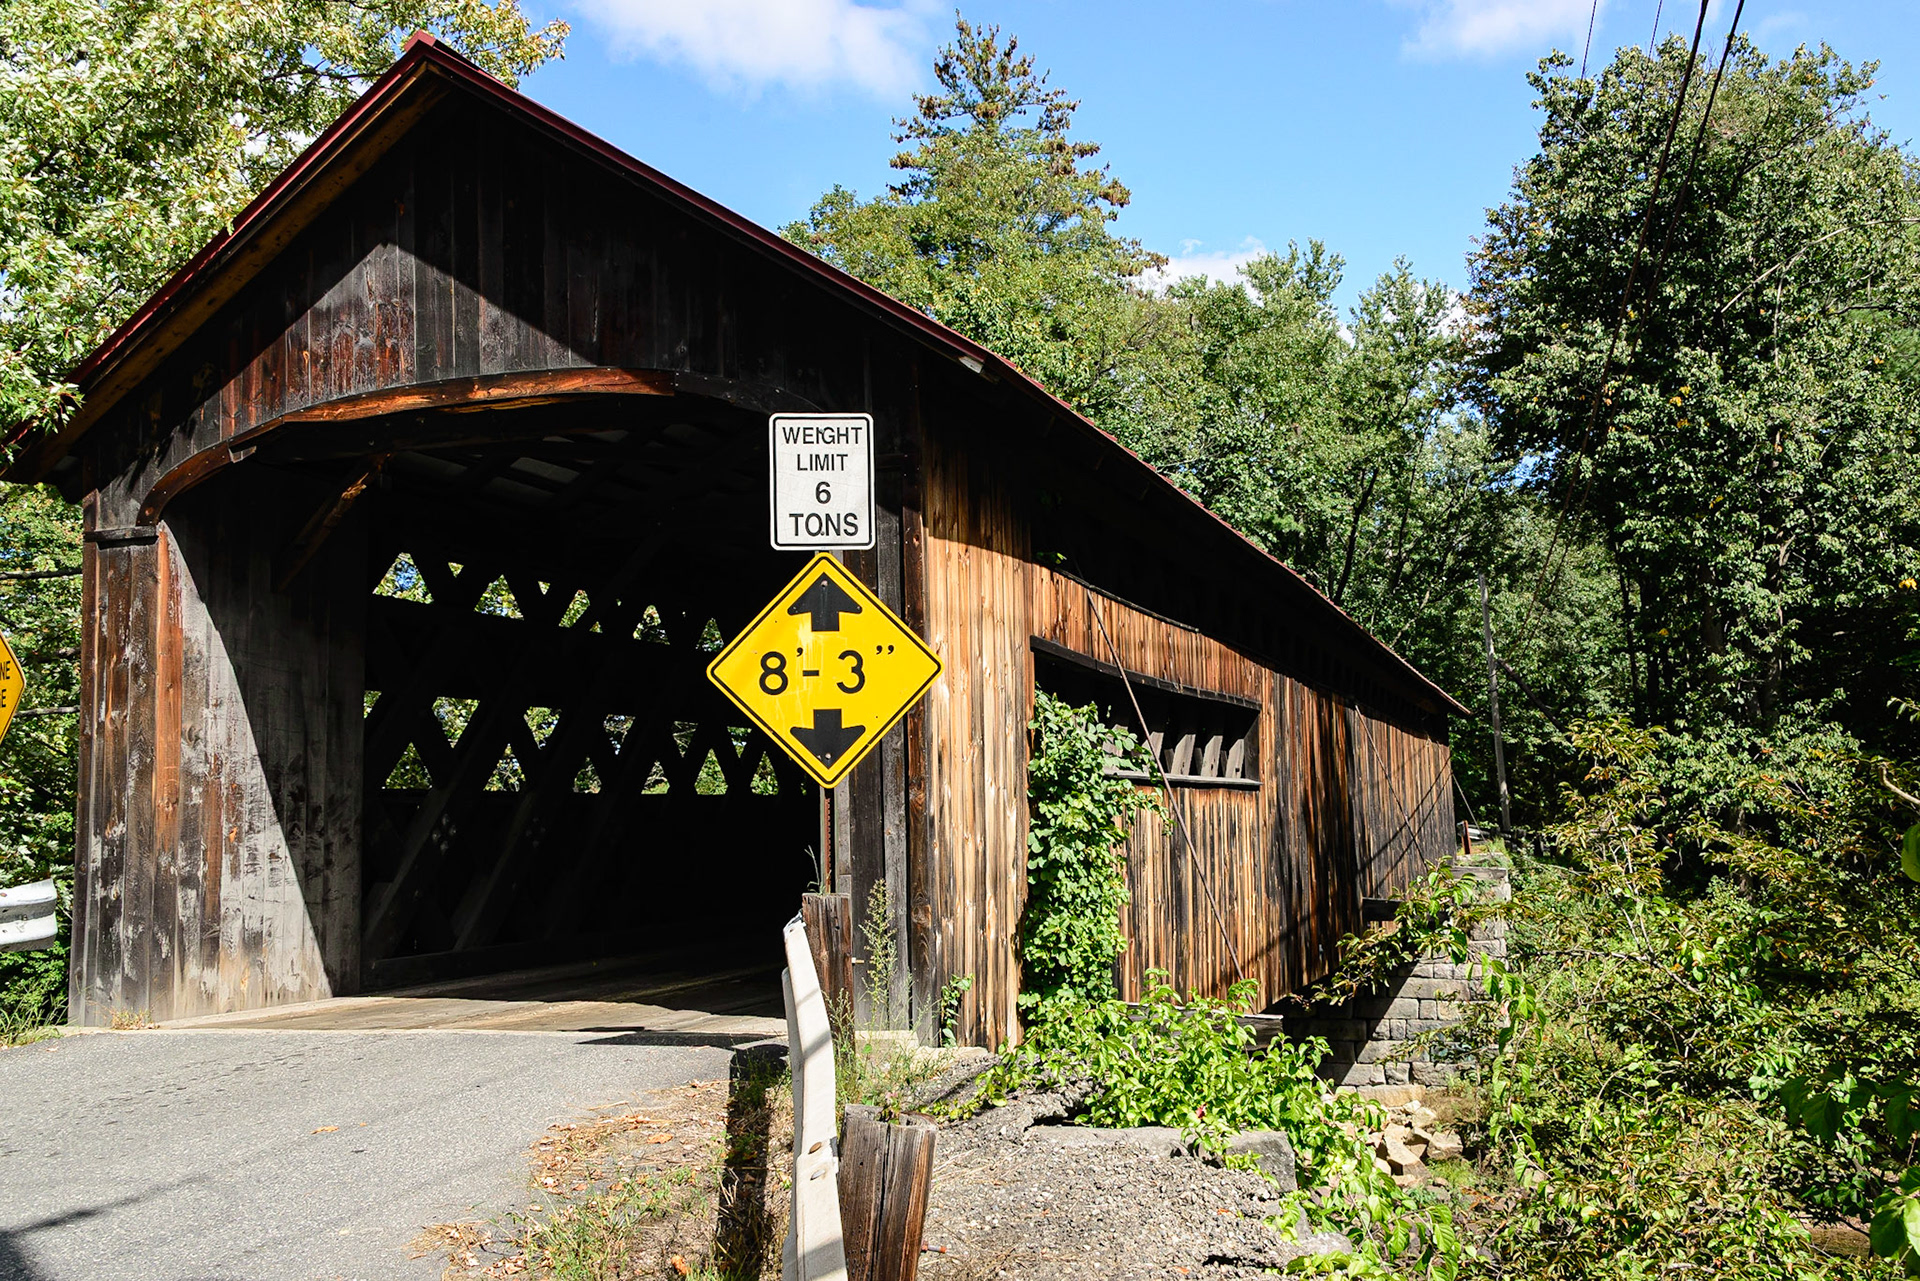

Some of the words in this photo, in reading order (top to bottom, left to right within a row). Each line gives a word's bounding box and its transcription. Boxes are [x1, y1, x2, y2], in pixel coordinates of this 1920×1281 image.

[782, 426, 862, 445] WEIGHT
[797, 453, 849, 472] LIMIT
[815, 481, 832, 505] 6
[788, 512, 859, 537] TONS
